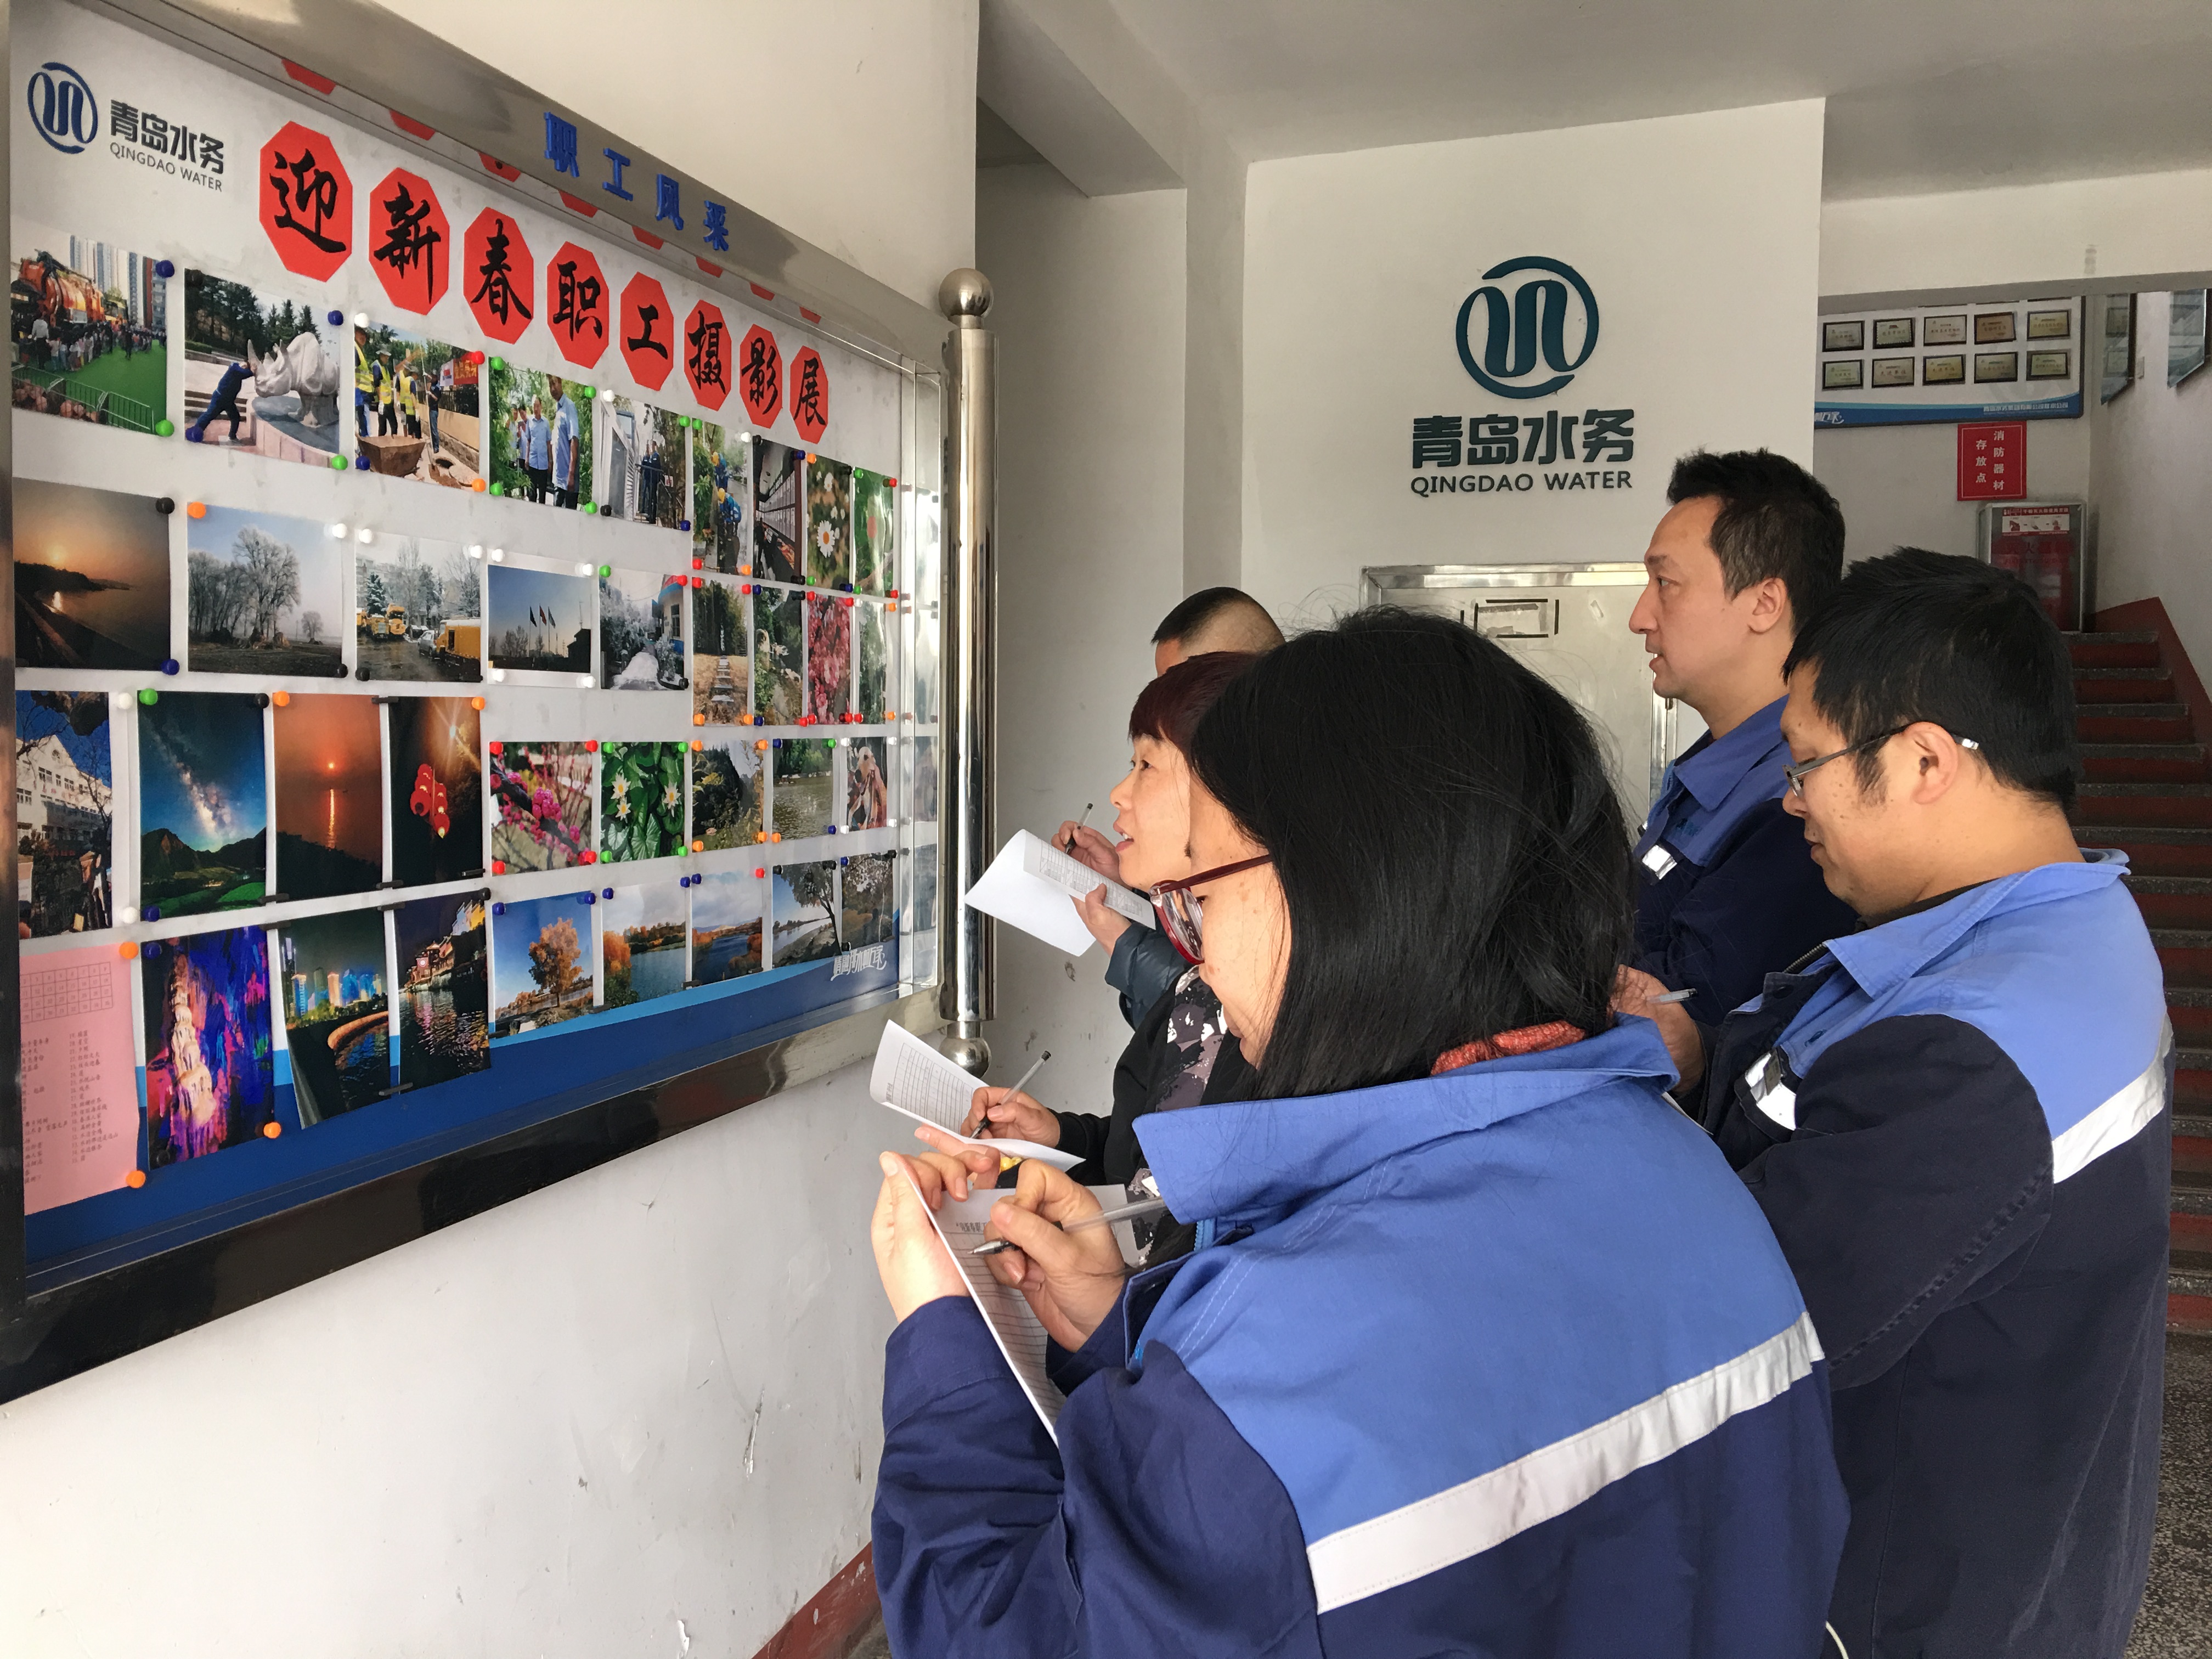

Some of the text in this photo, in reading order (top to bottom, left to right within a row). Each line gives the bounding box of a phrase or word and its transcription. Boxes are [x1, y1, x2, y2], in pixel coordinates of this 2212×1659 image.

[110, 99, 224, 176] 青岛水务
[110, 141, 223, 193] QINGDAO WATER
[544, 111, 729, 251] 职工风采
[269, 149, 826, 427] 迎新春职工摄影展
[1413, 409, 1634, 469] 青岛水务
[1976, 439, 1987, 483] 存放点
[1993, 431, 2005, 490] 消防器材
[1410, 471, 1633, 497] QINGDAO WATER
